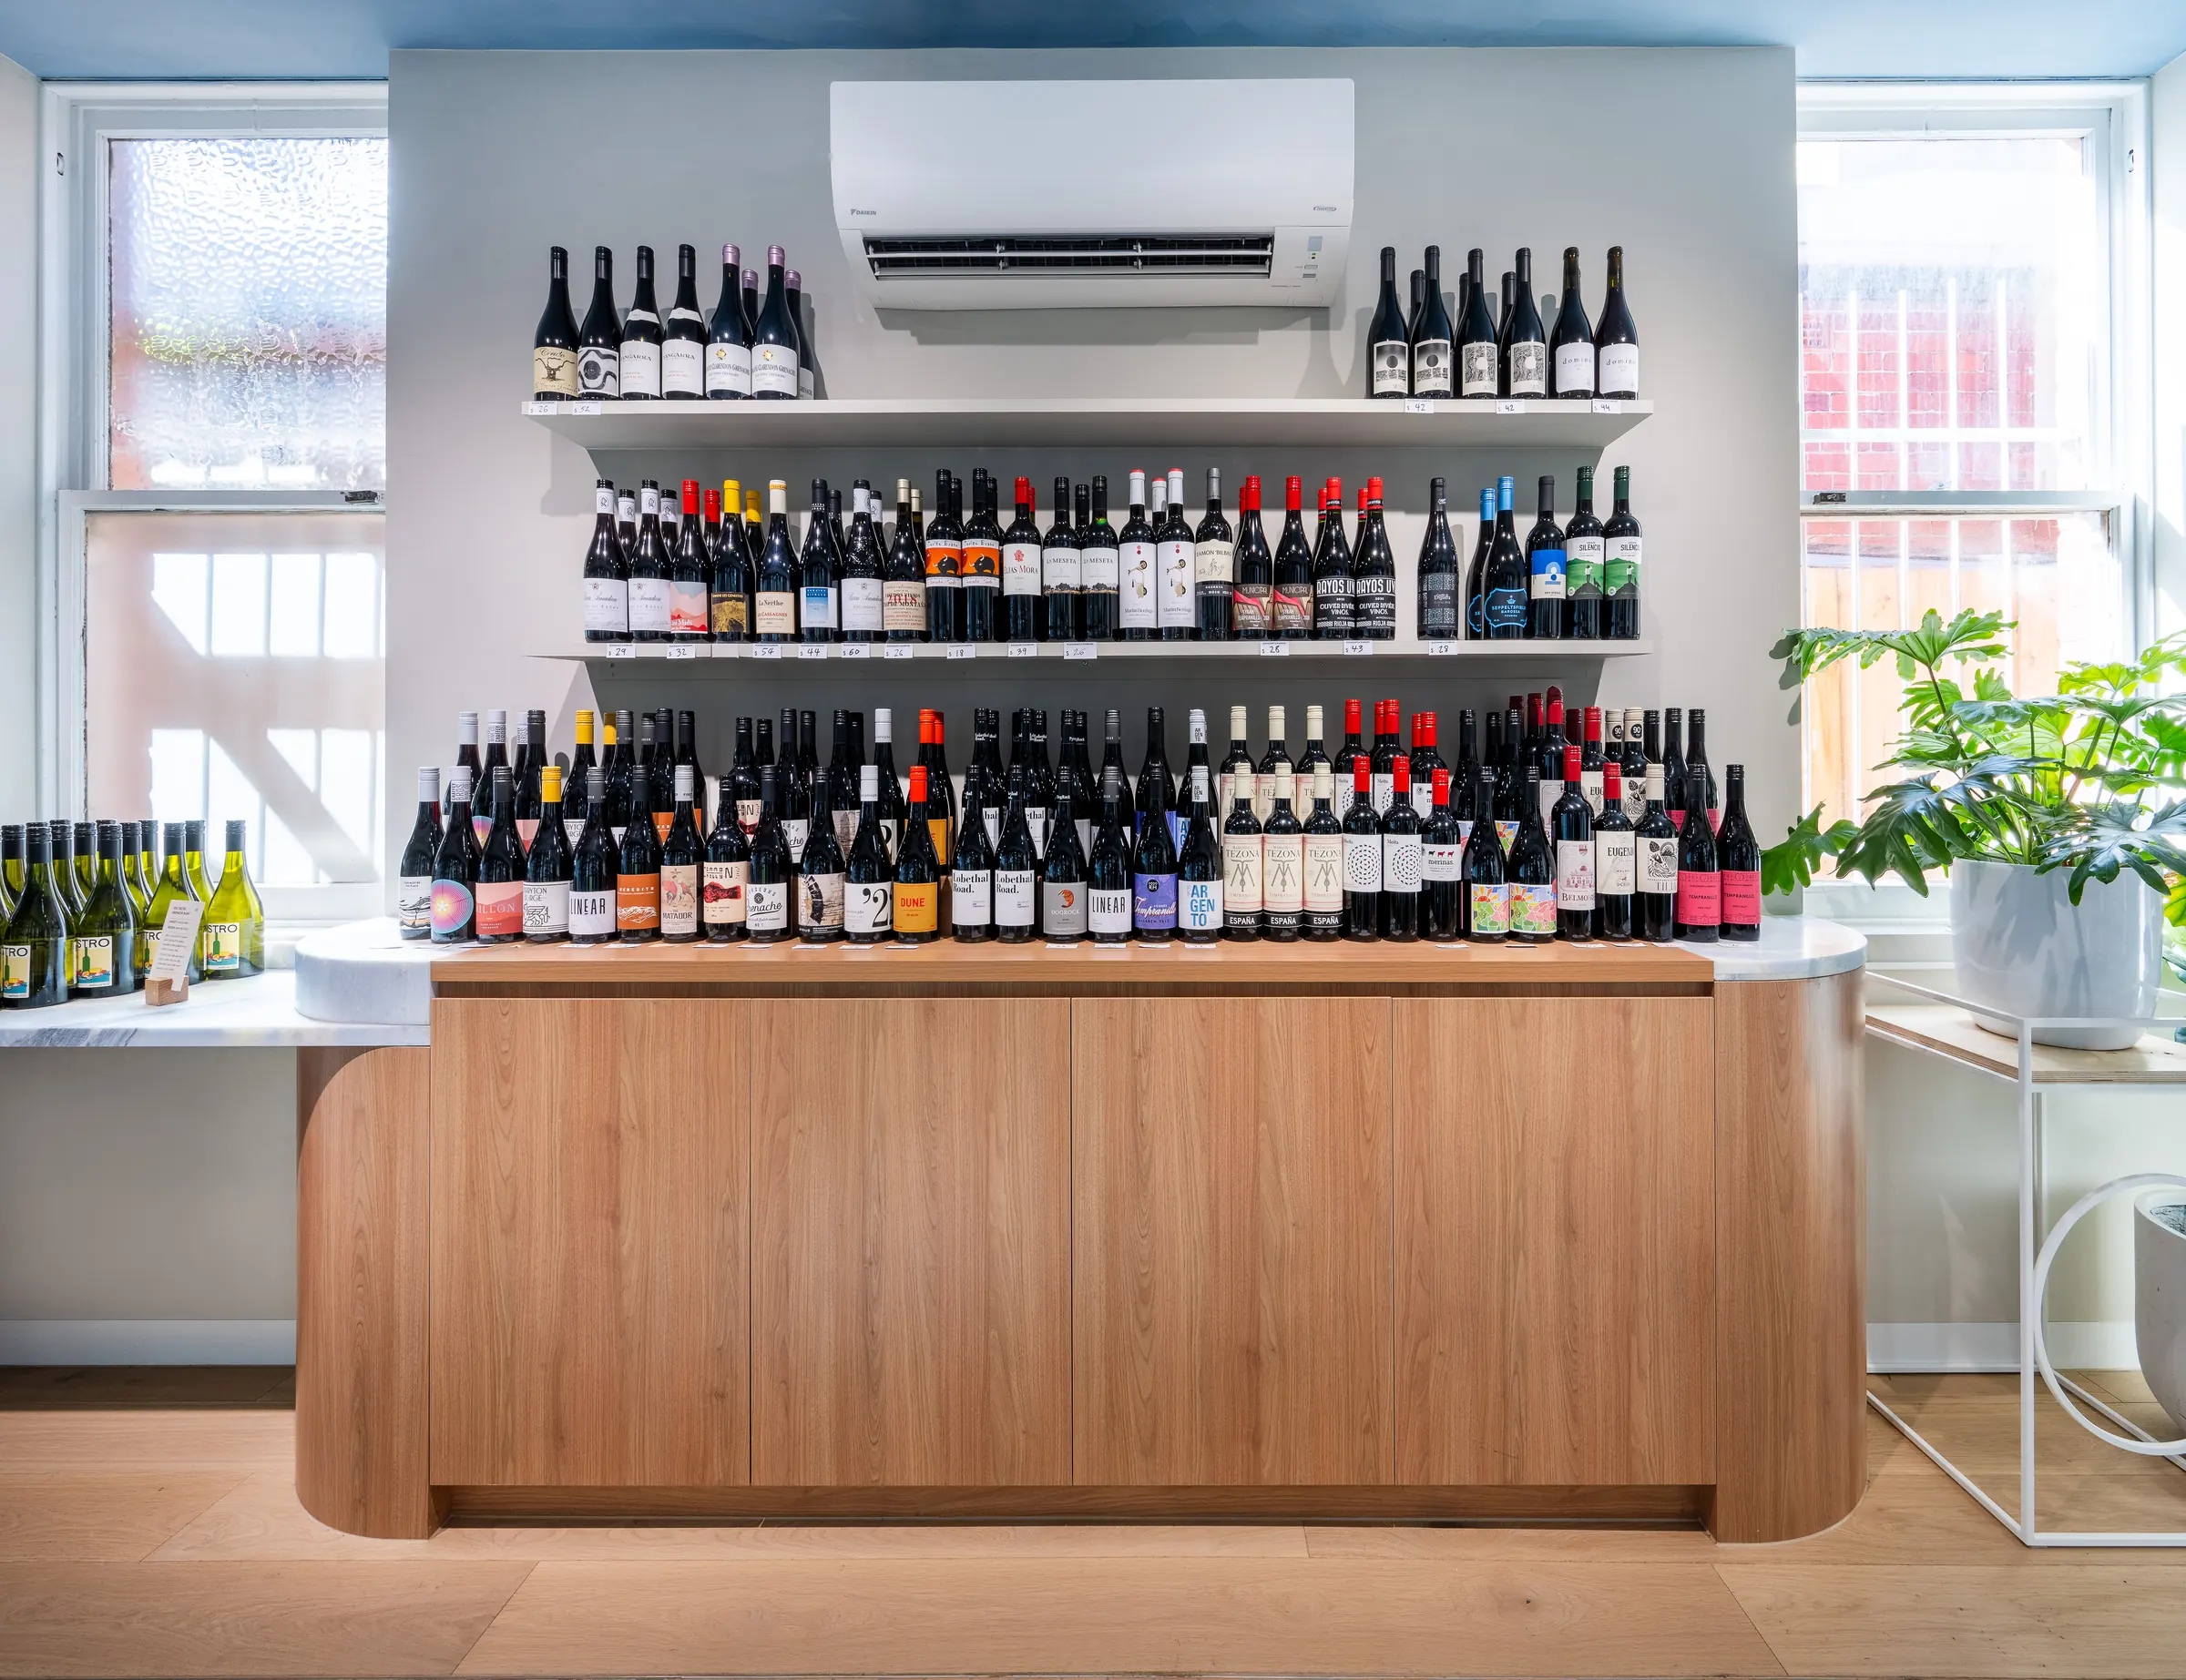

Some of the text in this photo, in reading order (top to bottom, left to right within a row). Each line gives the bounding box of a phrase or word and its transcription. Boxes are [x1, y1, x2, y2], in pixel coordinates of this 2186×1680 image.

[1019, 565, 1038, 574] MORA
[1317, 580, 1344, 594] RAYOS
[1357, 579, 1383, 594] RAYOS
[616, 648, 627, 656] 29
[676, 648, 687, 657] 32
[761, 647, 774, 656] 54
[807, 648, 821, 656] 44
[1017, 648, 1027, 656] 39
[1351, 645, 1364, 653] 43
[953, 873, 988, 883] Lobethal
[996, 873, 1032, 884] Lobethal
[1191, 885, 1208, 898] AR
[570, 898, 606, 915] LINEAR
[900, 898, 925, 907] DUNE
[1093, 896, 1125, 914] LINEAR
[1190, 898, 1215, 912] GEN
[1190, 913, 1207, 927] TO
[1230, 916, 1255, 925] ESPAÑA
[1271, 916, 1296, 925] ESPAÑA
[1313, 916, 1339, 925] ESPAÑA
